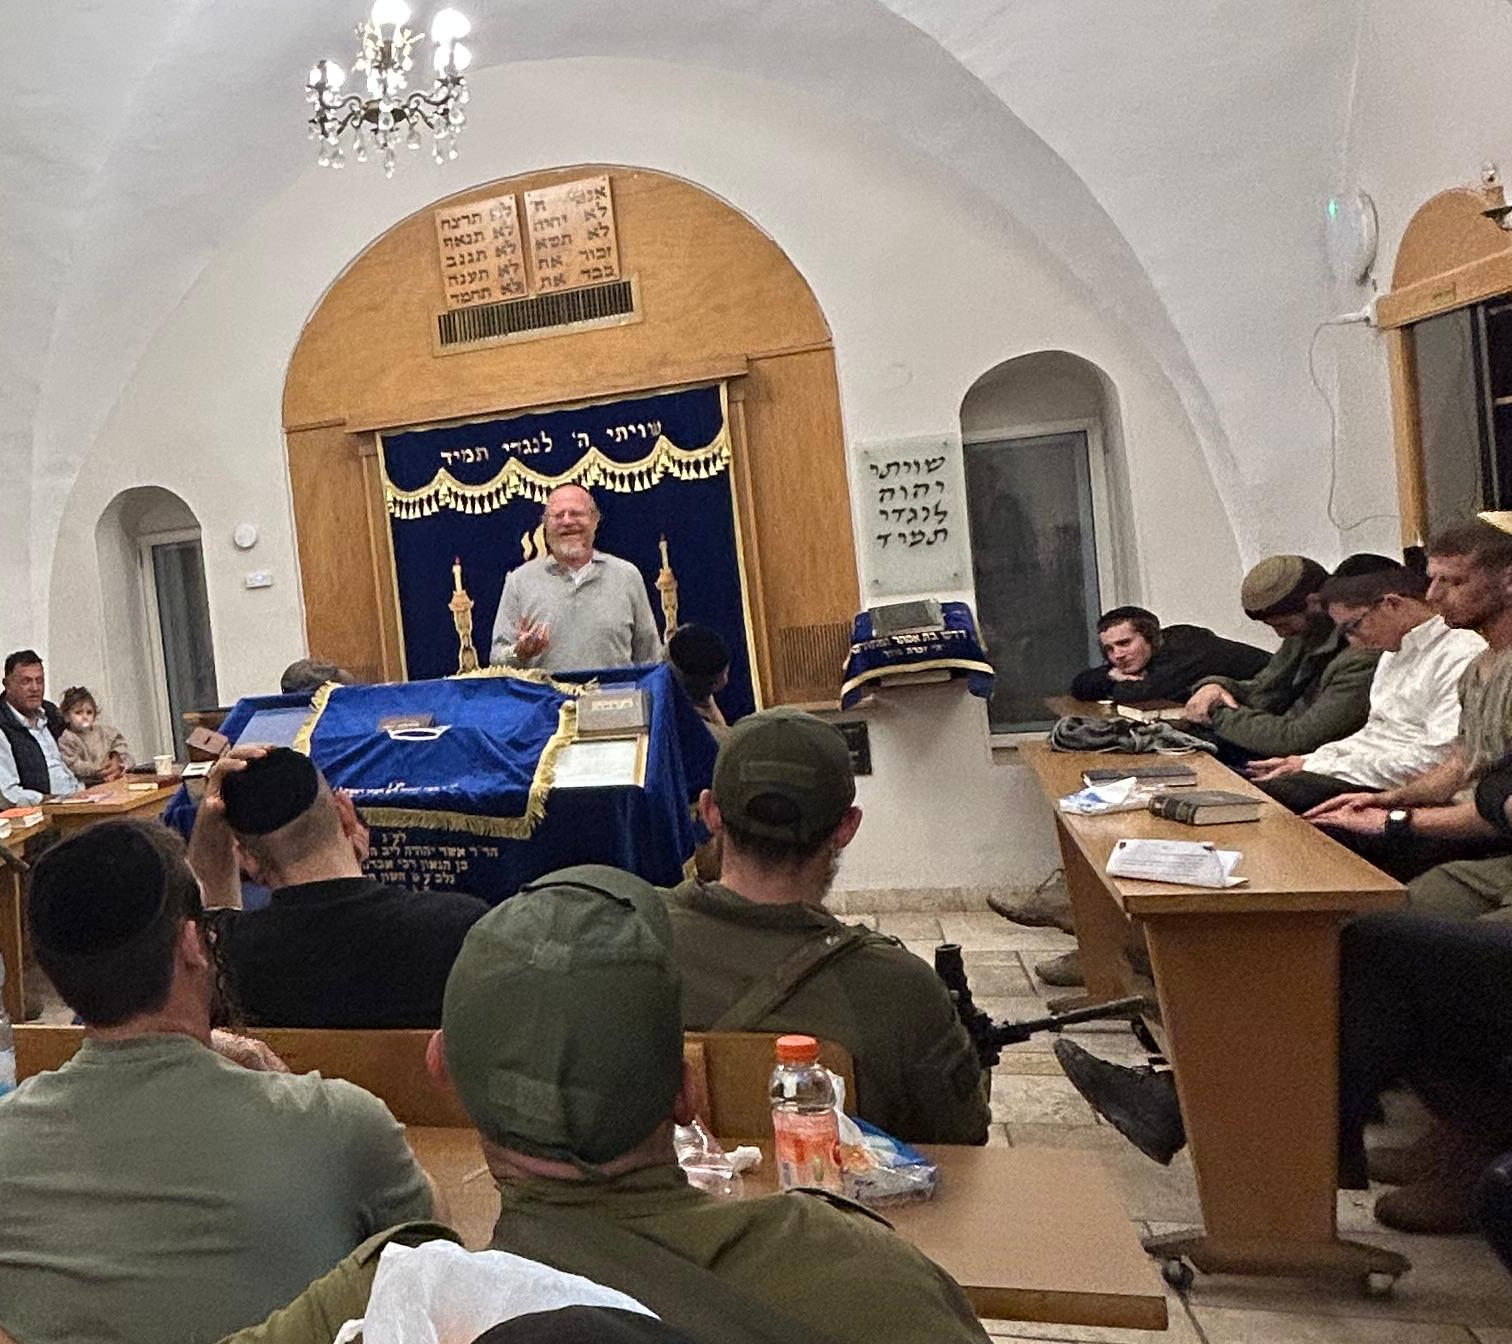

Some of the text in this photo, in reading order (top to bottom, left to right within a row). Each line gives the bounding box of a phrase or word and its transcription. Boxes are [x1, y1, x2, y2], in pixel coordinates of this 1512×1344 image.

[440, 212, 483, 231] תרצח
[584, 201, 608, 223] לא
[443, 224, 514, 251] לא תנאף
[587, 221, 610, 241] לא
[445, 240, 517, 269] לא תגנב
[538, 245, 613, 271] זכור את
[447, 258, 520, 287] לא תענה
[540, 272, 567, 292] את
[449, 276, 525, 305] לא תחמד
[440, 420, 663, 465] שויתי ה' לנגדי תמיד
[869, 455, 946, 481] שויתי
[879, 480, 945, 504] יהוה
[879, 500, 949, 525] לנגדי
[877, 527, 949, 548] תמיד
